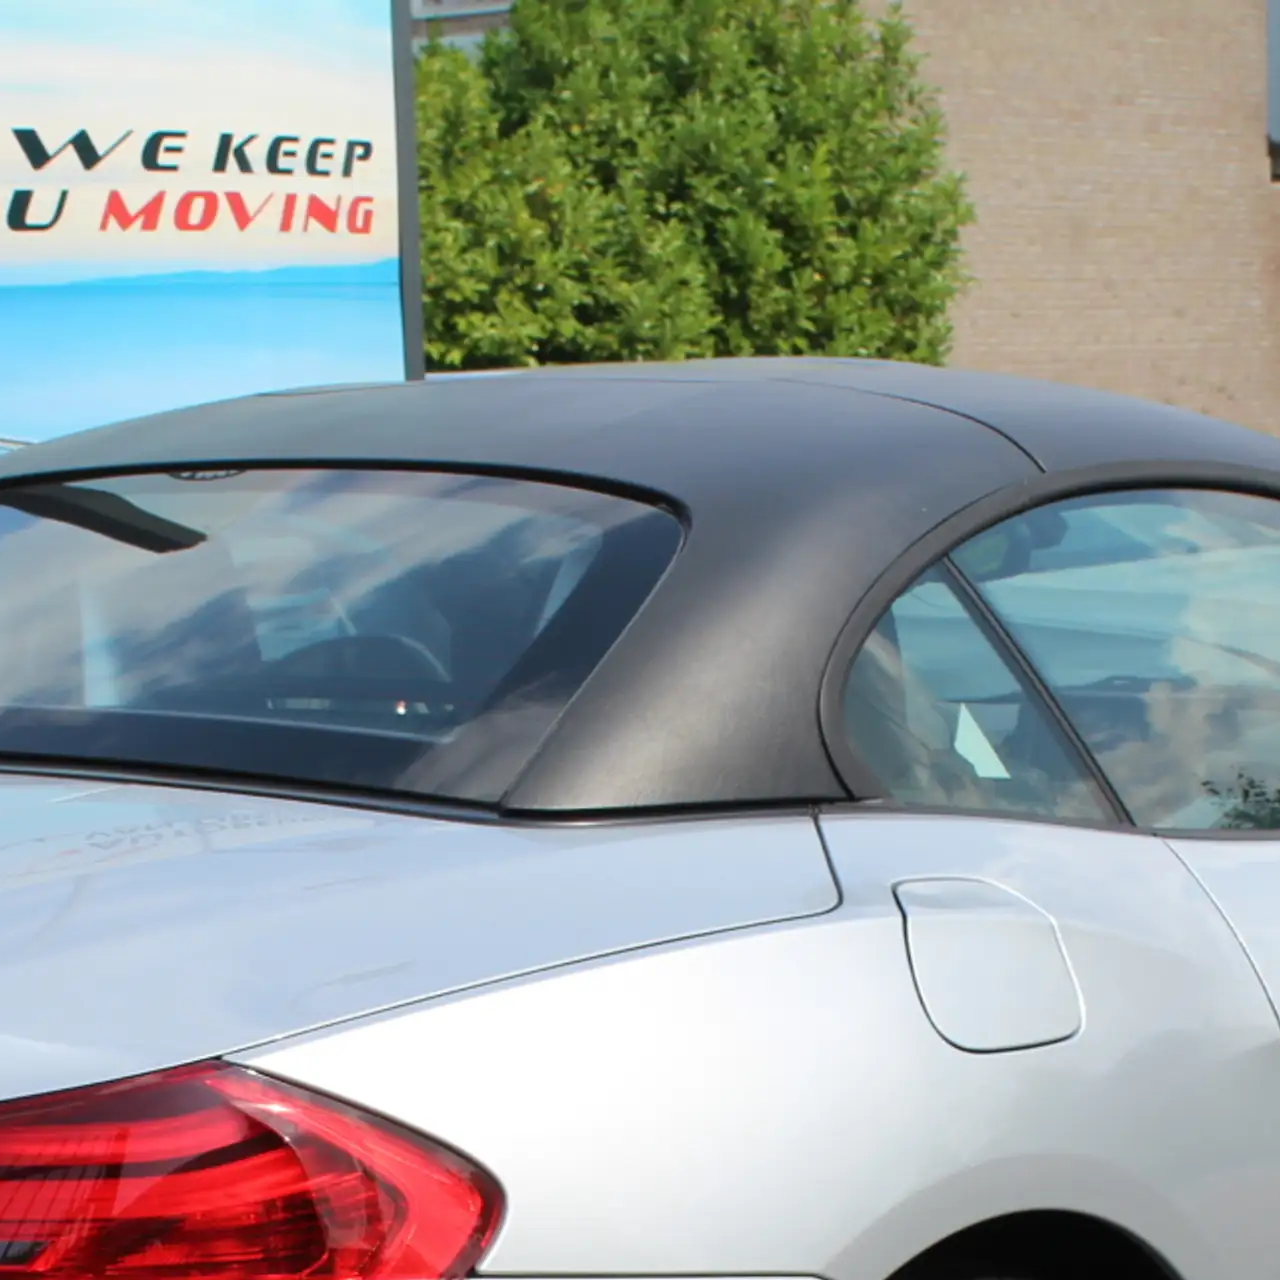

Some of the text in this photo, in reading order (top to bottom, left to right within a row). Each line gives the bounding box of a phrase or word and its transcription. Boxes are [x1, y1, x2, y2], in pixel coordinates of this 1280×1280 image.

[11, 127, 374, 179] WE KEEP
[97, 188, 375, 236] MOVING
